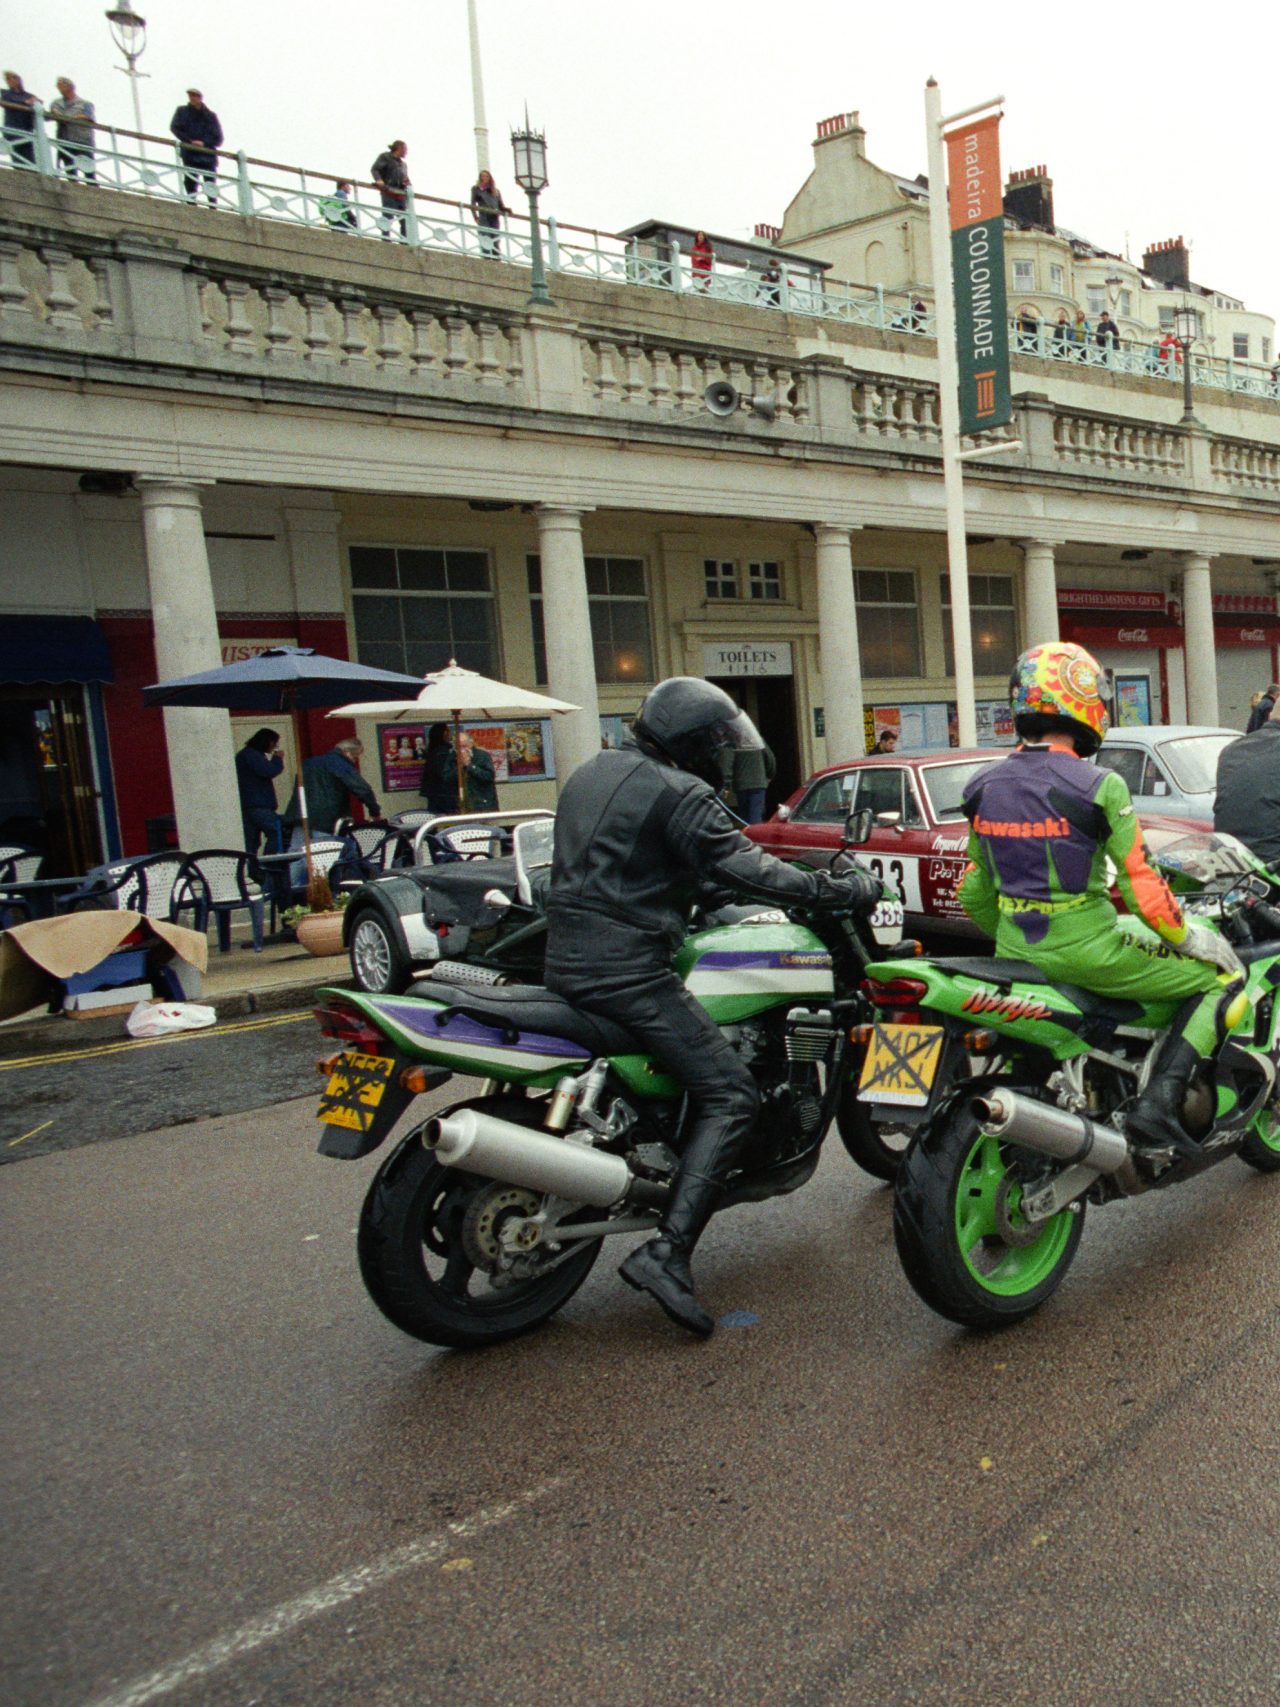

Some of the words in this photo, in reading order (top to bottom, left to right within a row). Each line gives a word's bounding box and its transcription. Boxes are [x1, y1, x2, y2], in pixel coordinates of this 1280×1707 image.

[964, 133, 986, 219] madeira
[968, 226, 994, 360] COLONNADE
[718, 651, 777, 663] TOILETS
[870, 901, 905, 927] 333
[961, 985, 1053, 1022] Ninja
